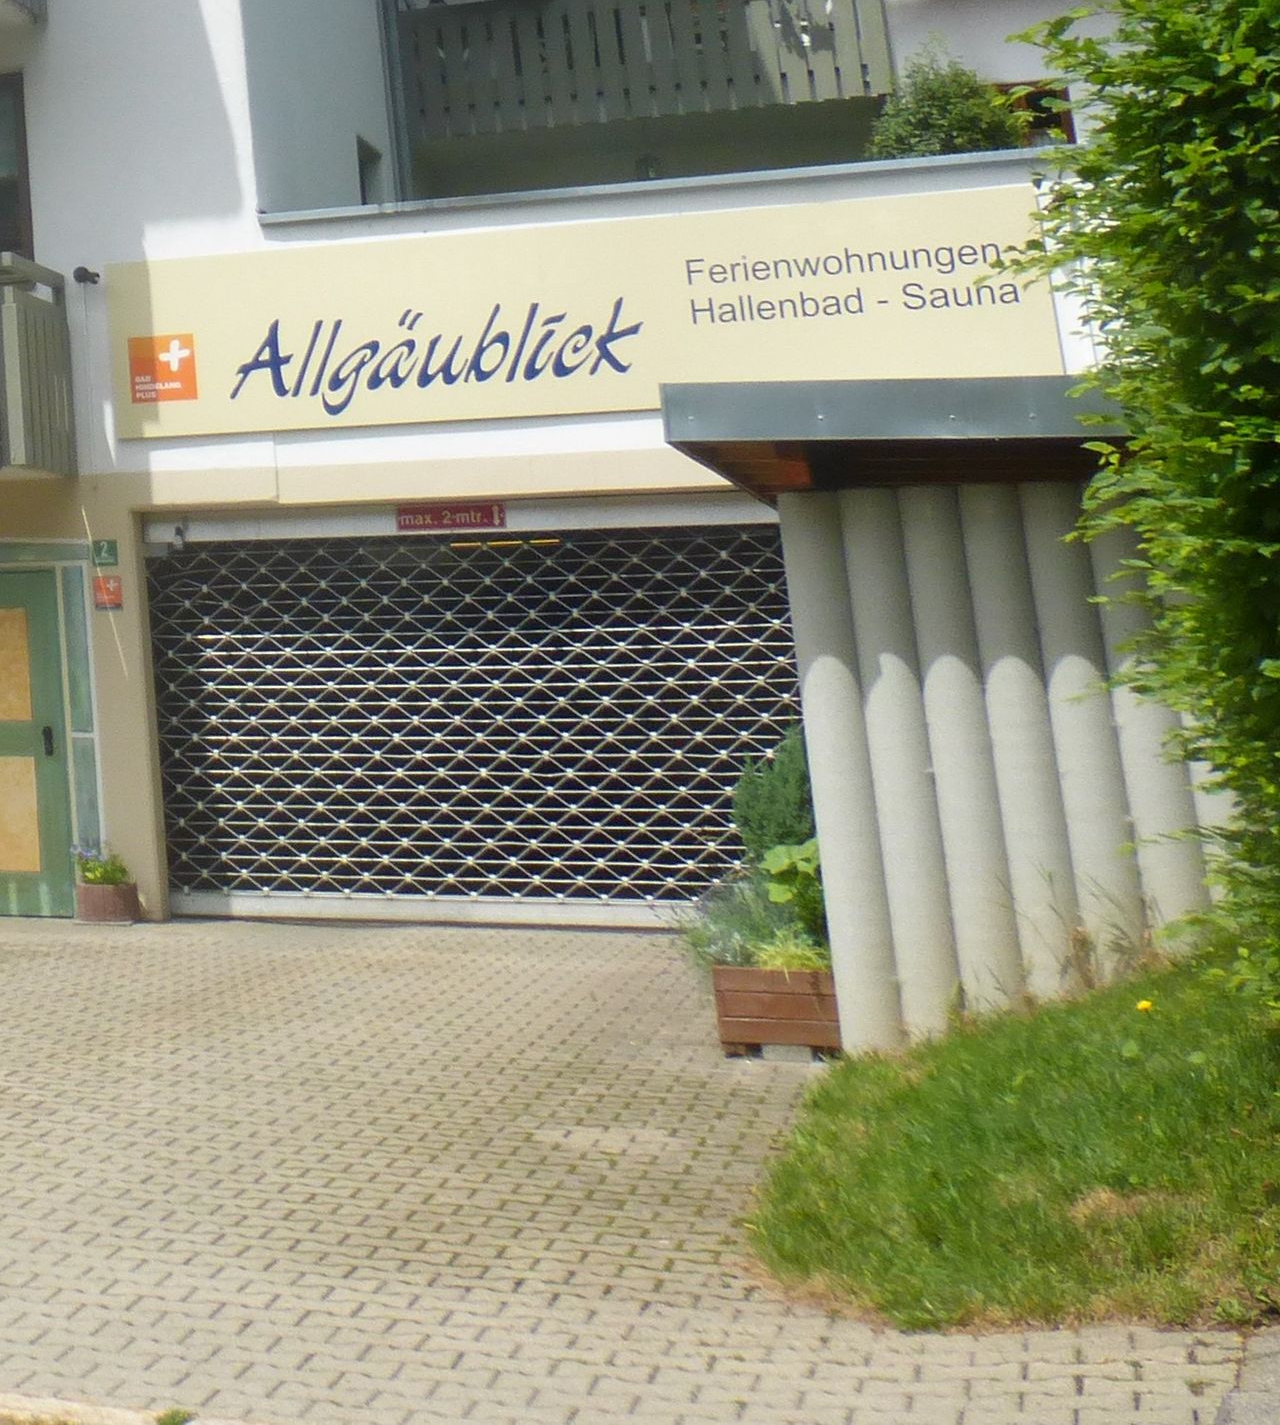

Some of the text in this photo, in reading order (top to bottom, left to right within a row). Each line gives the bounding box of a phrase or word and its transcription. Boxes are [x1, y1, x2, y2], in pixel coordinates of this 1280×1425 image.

[685, 242, 1001, 285] Ferienwohnungen
[690, 287, 864, 324] Hallenbad
[902, 281, 1021, 311] Sauna
[230, 296, 643, 416] Allgäublick
[136, 390, 156, 399] PLUS
[400, 513, 438, 525] max.
[100, 541, 109, 557] 2
